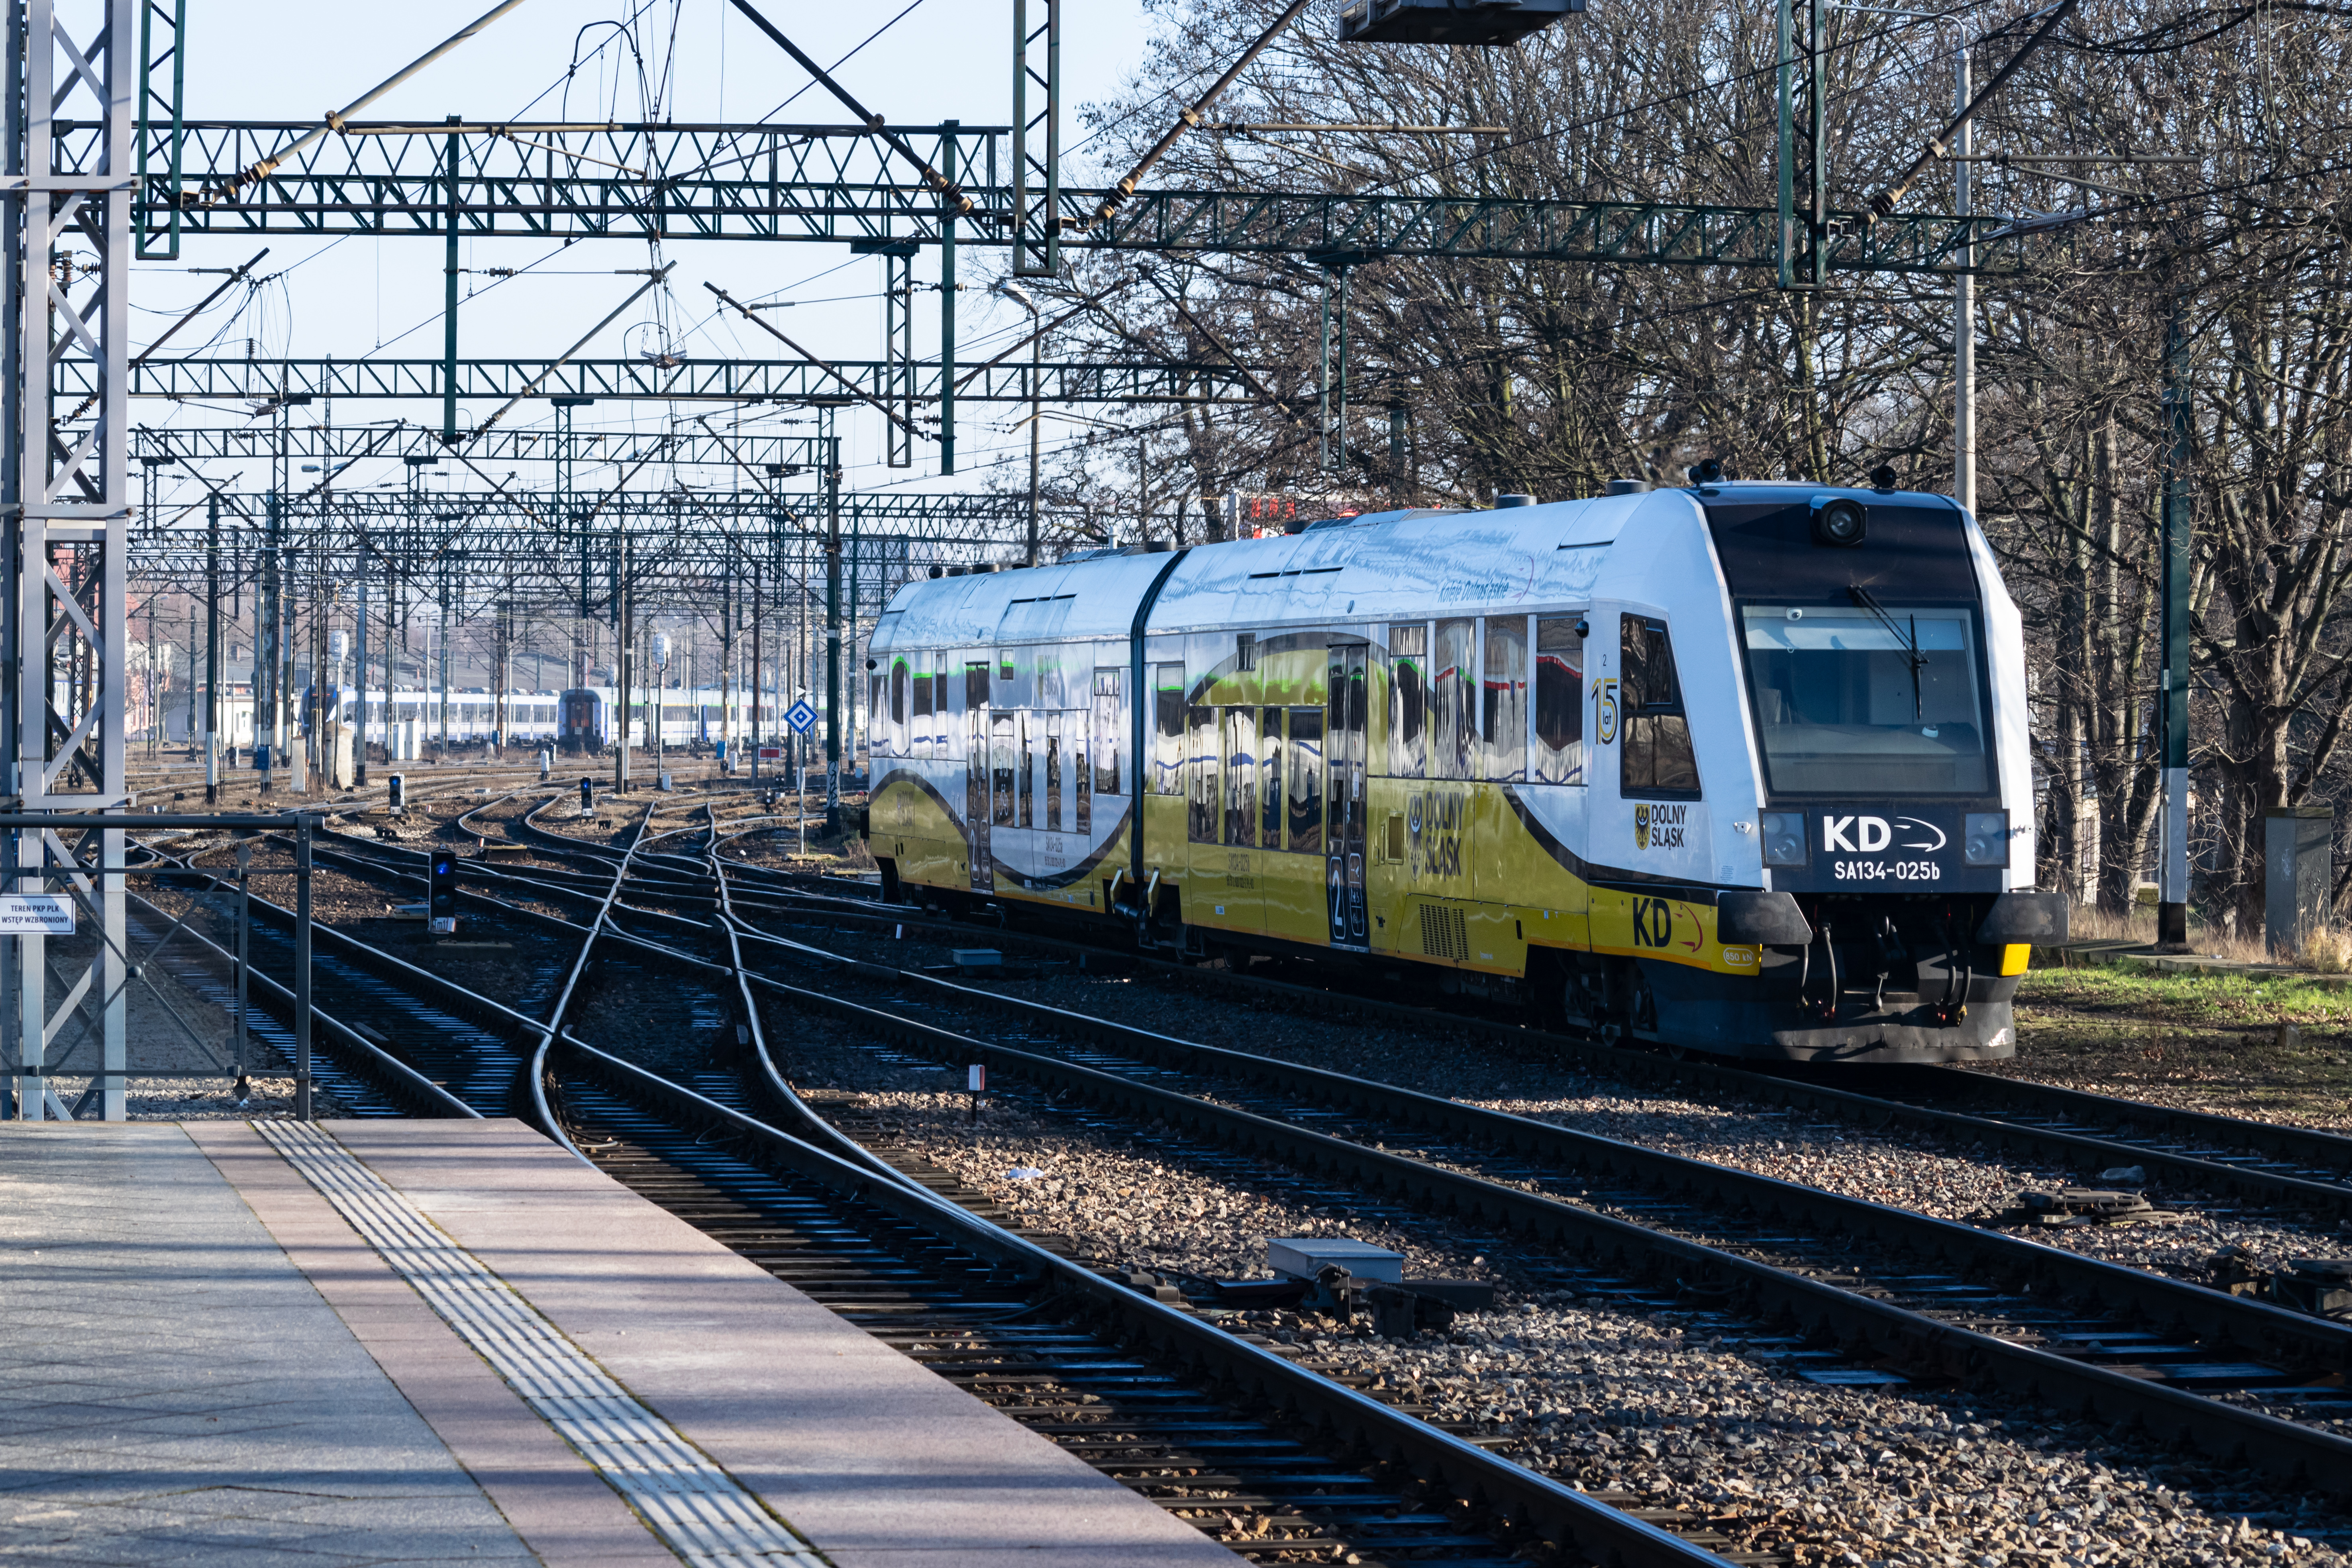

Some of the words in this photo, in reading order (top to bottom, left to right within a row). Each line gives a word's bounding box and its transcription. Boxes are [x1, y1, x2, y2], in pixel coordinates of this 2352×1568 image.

[1603, 654, 1607, 666] 2
[1591, 678, 1618, 745] 15
[1603, 711, 1611, 725] lat
[1426, 791, 1465, 830] DOLNY
[1652, 804, 1687, 824] DOLNY
[970, 829, 978, 871] 2
[1651, 822, 1684, 850] ŚLĄSK
[1824, 816, 1891, 852] KD
[1425, 827, 1461, 882] ŚLĄSK
[1835, 861, 1940, 880] SA134-025b
[1332, 870, 1343, 926] 2
[2, 916, 23, 924] WSTĘP
[1633, 897, 1672, 948] KD
[1726, 952, 1740, 961] 850
[1742, 953, 1752, 962] kN
